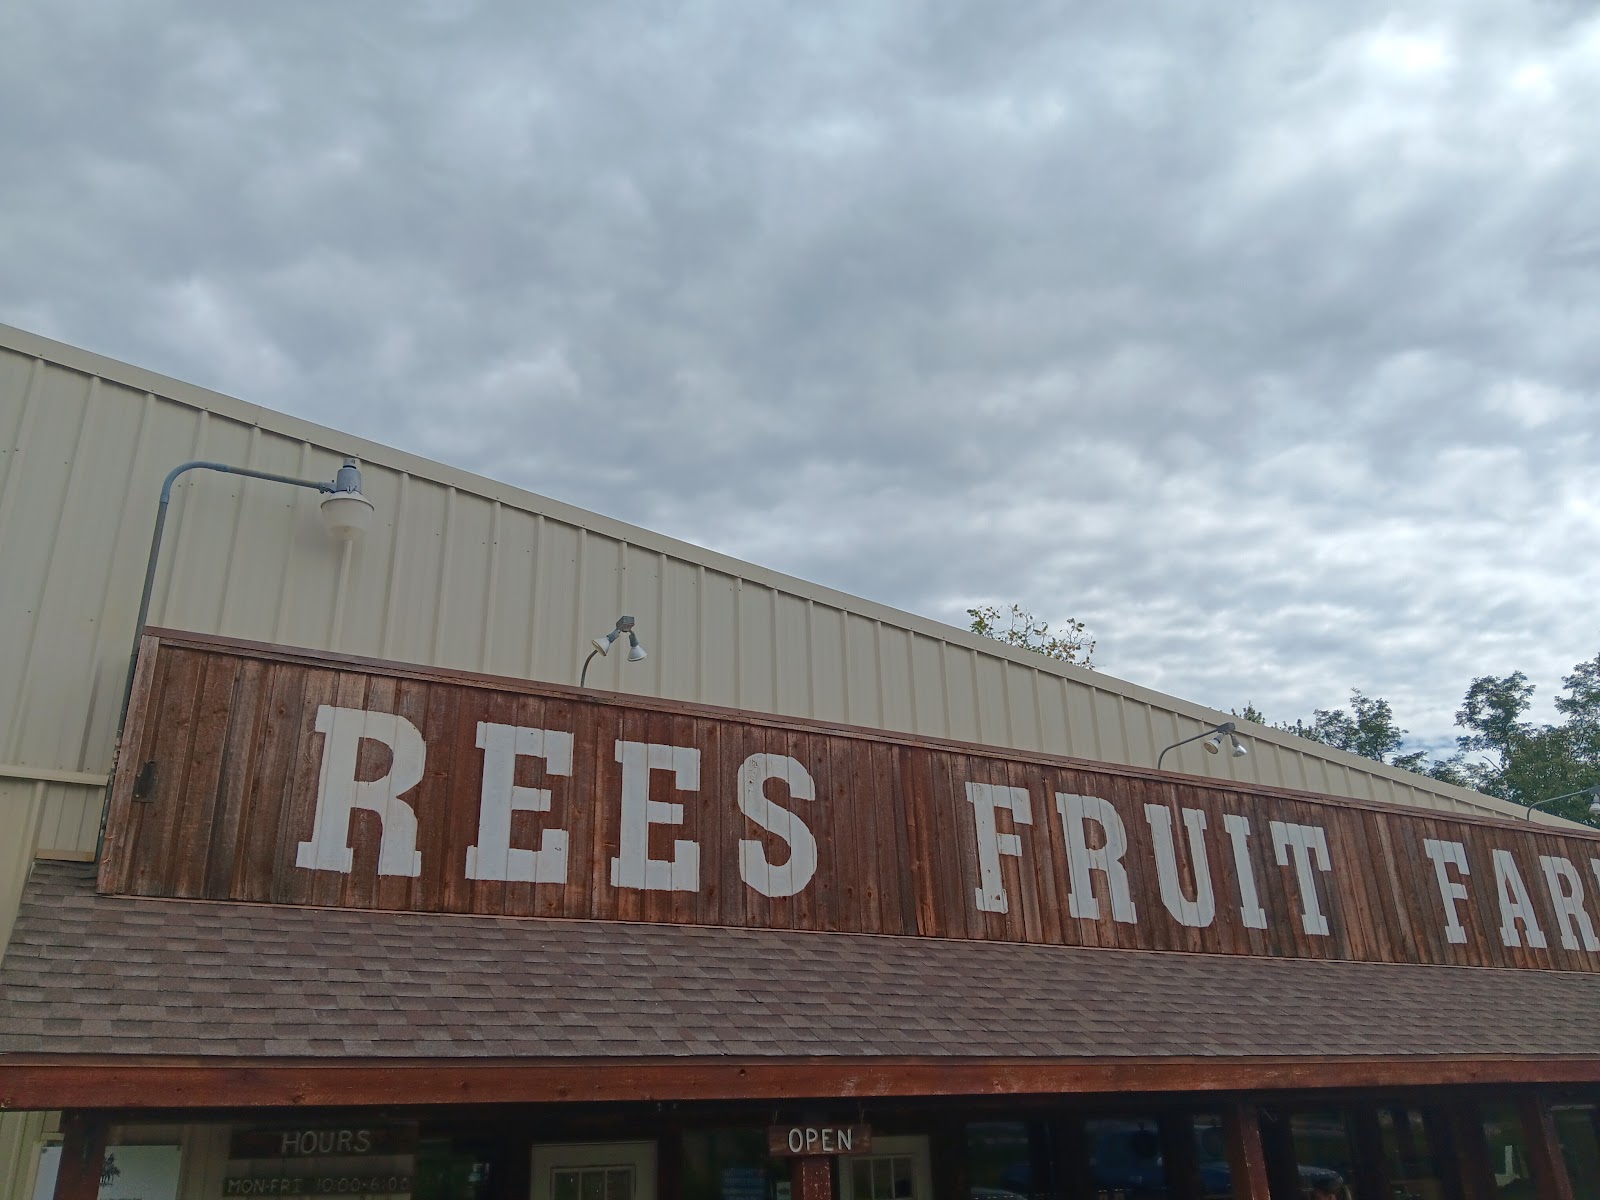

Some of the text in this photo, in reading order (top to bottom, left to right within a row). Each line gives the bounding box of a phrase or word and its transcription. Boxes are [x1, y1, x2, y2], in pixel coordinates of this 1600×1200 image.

[295, 705, 1600, 952] REES FRUIT FAR
[281, 1130, 371, 1154] HOURS
[788, 1128, 852, 1153] OPEN
